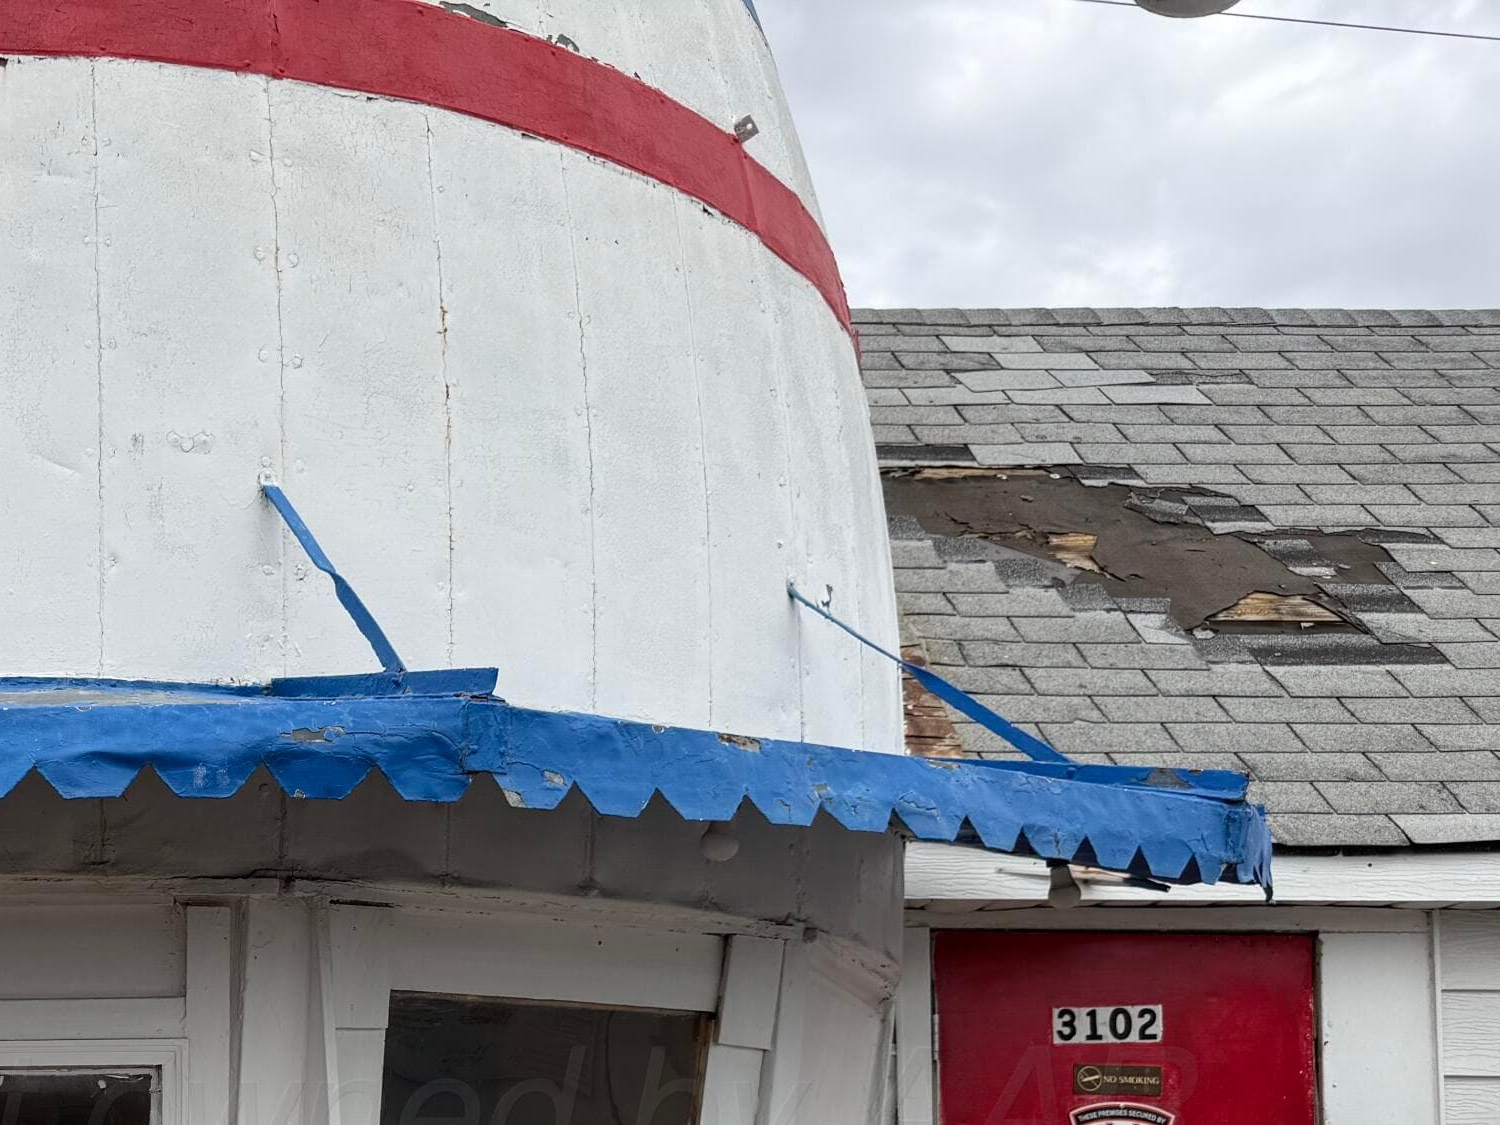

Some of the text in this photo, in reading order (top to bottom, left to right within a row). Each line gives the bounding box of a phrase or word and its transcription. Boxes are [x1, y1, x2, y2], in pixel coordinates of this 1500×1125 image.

[1056, 1007, 1158, 1041] 3102
[1103, 1075, 1160, 1085] NO SMOKING
